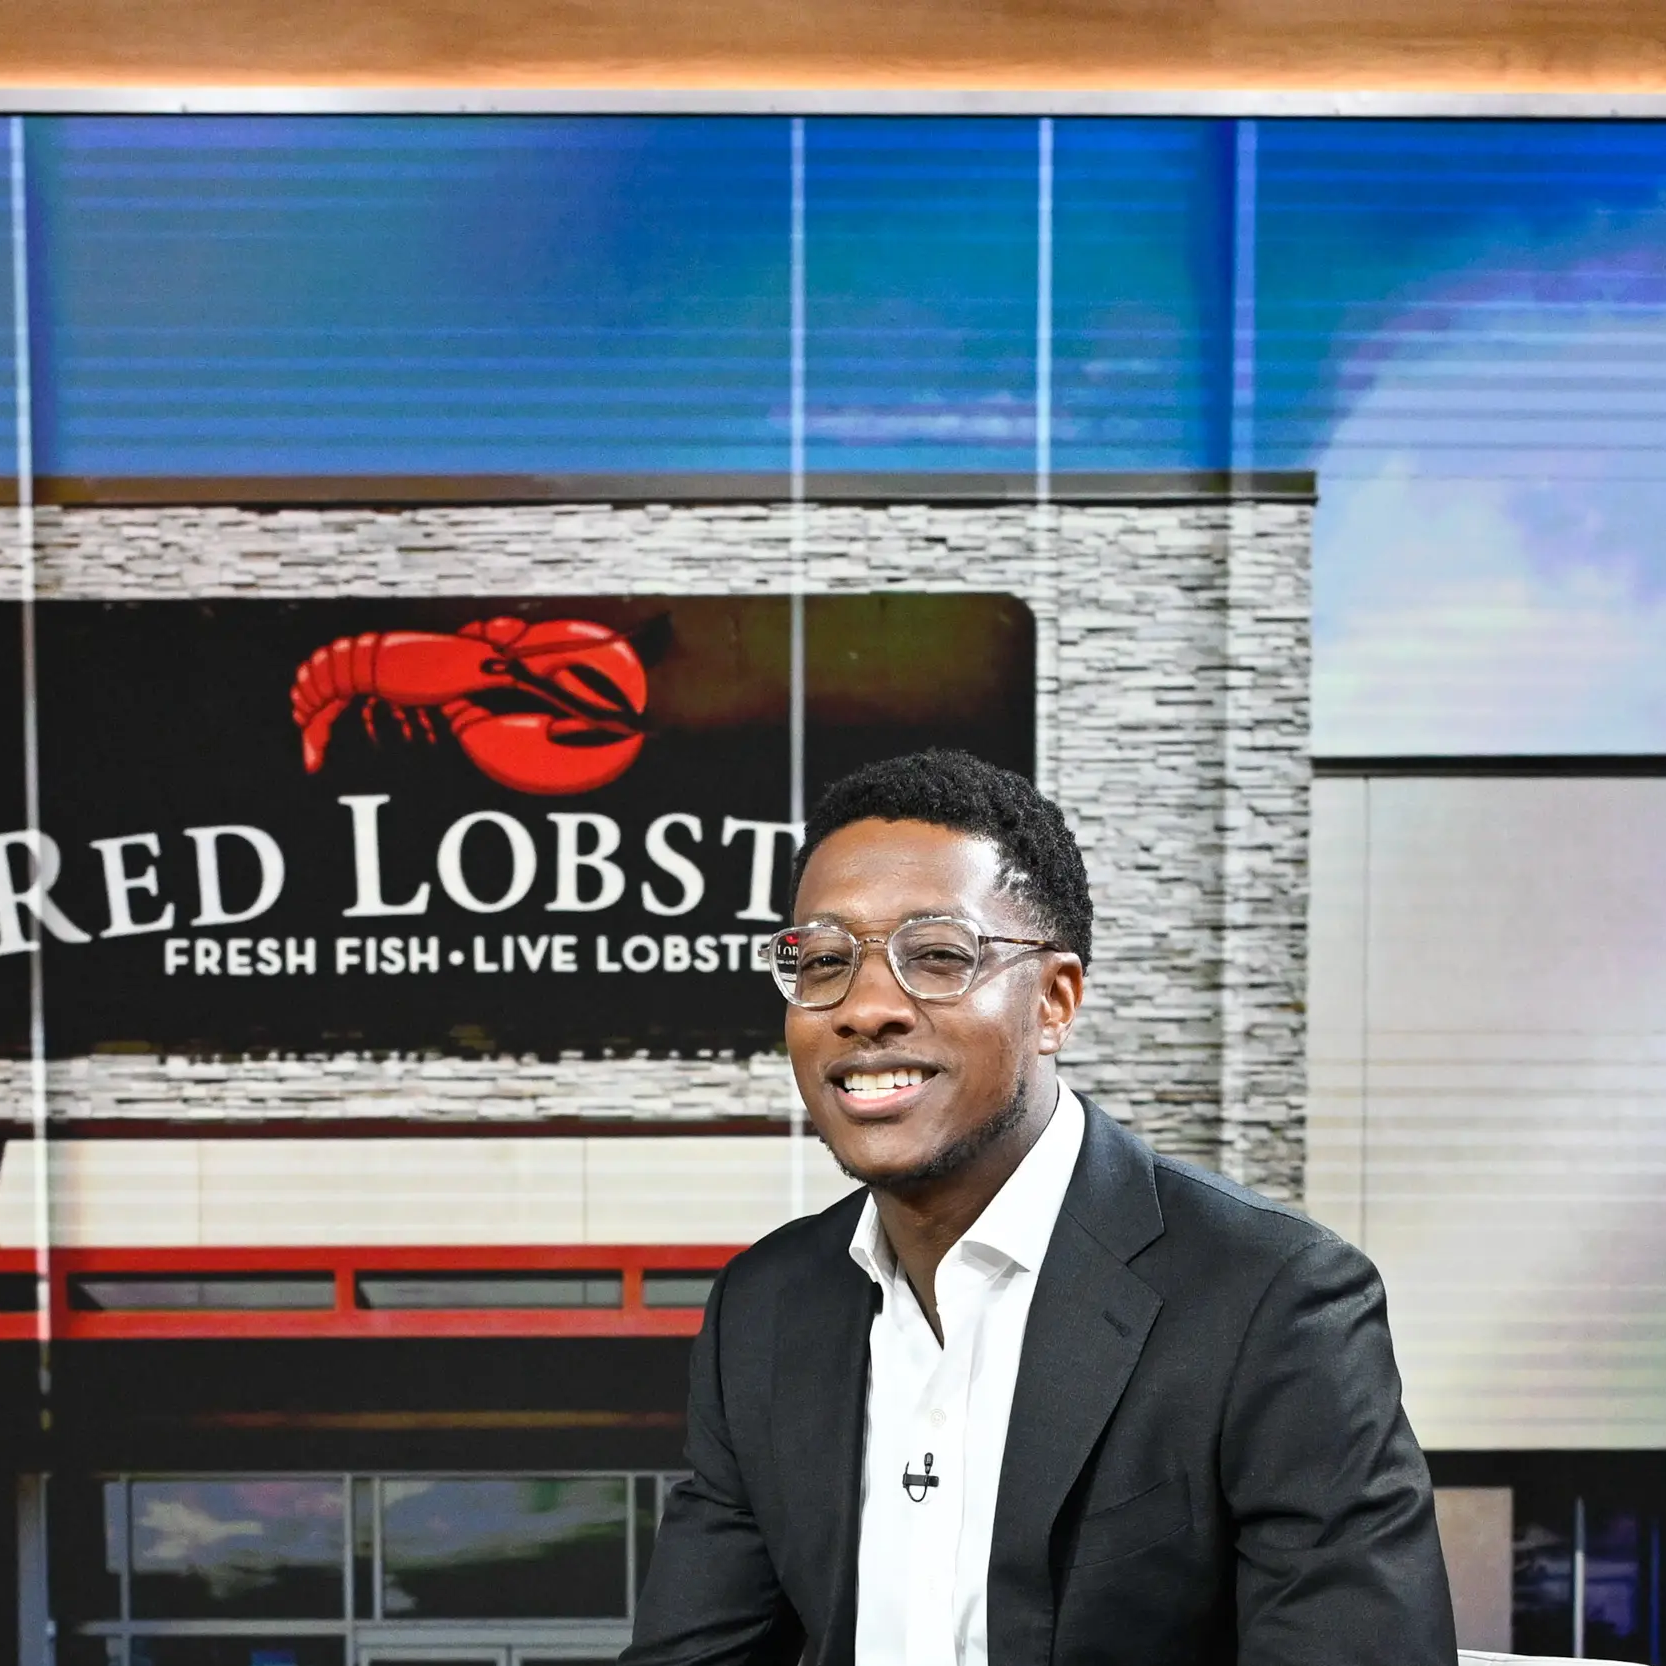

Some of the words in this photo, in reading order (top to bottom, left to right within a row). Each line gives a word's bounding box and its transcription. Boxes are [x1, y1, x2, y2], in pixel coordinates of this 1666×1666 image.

[337, 794, 807, 922] LOBST
[164, 936, 317, 976] FRESH
[596, 933, 772, 973] LOBSTE
